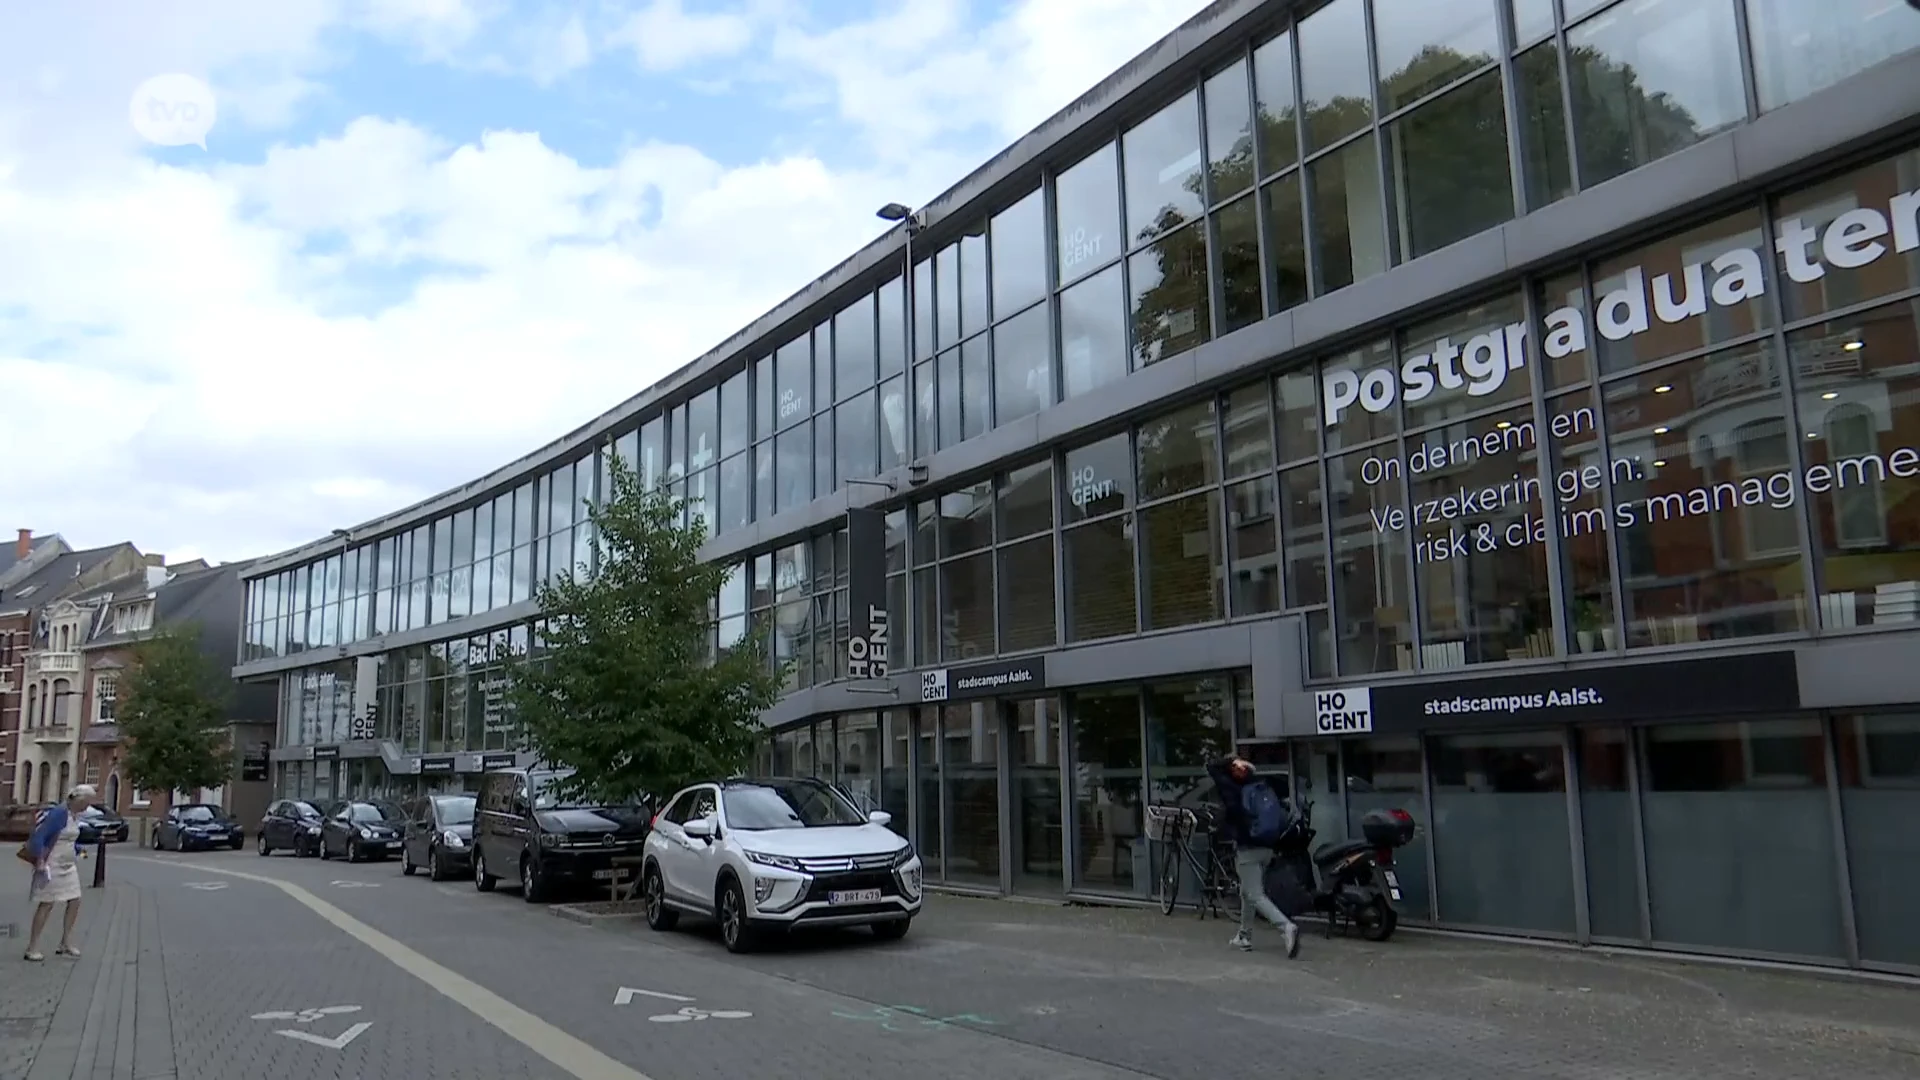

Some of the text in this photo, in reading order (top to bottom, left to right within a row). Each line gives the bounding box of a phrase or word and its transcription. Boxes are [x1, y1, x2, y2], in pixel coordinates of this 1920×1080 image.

[1064, 226, 1085, 252] HO
[1064, 233, 1102, 268] GENT
[780, 388, 794, 405] HO
[780, 396, 802, 419] GENT
[1361, 407, 1594, 485] Ondernemen
[1072, 465, 1094, 487] HO
[1072, 480, 1112, 506] GENT
[1370, 455, 1643, 534] Verzekeringen:
[1415, 528, 1468, 564] risk
[1476, 523, 1498, 552] &
[1505, 501, 1635, 548] claims
[869, 604, 887, 680] GENT
[849, 636, 868, 679] HO
[923, 672, 936, 687] HO
[923, 685, 946, 699] GENT
[957, 669, 1032, 690] stadscampus Aalst.
[1318, 692, 1346, 711] HO
[1424, 687, 1603, 715] stadscampus Aalst.
[353, 718, 365, 740] HO
[366, 702, 378, 740] GENT
[1318, 711, 1368, 731] GENT
